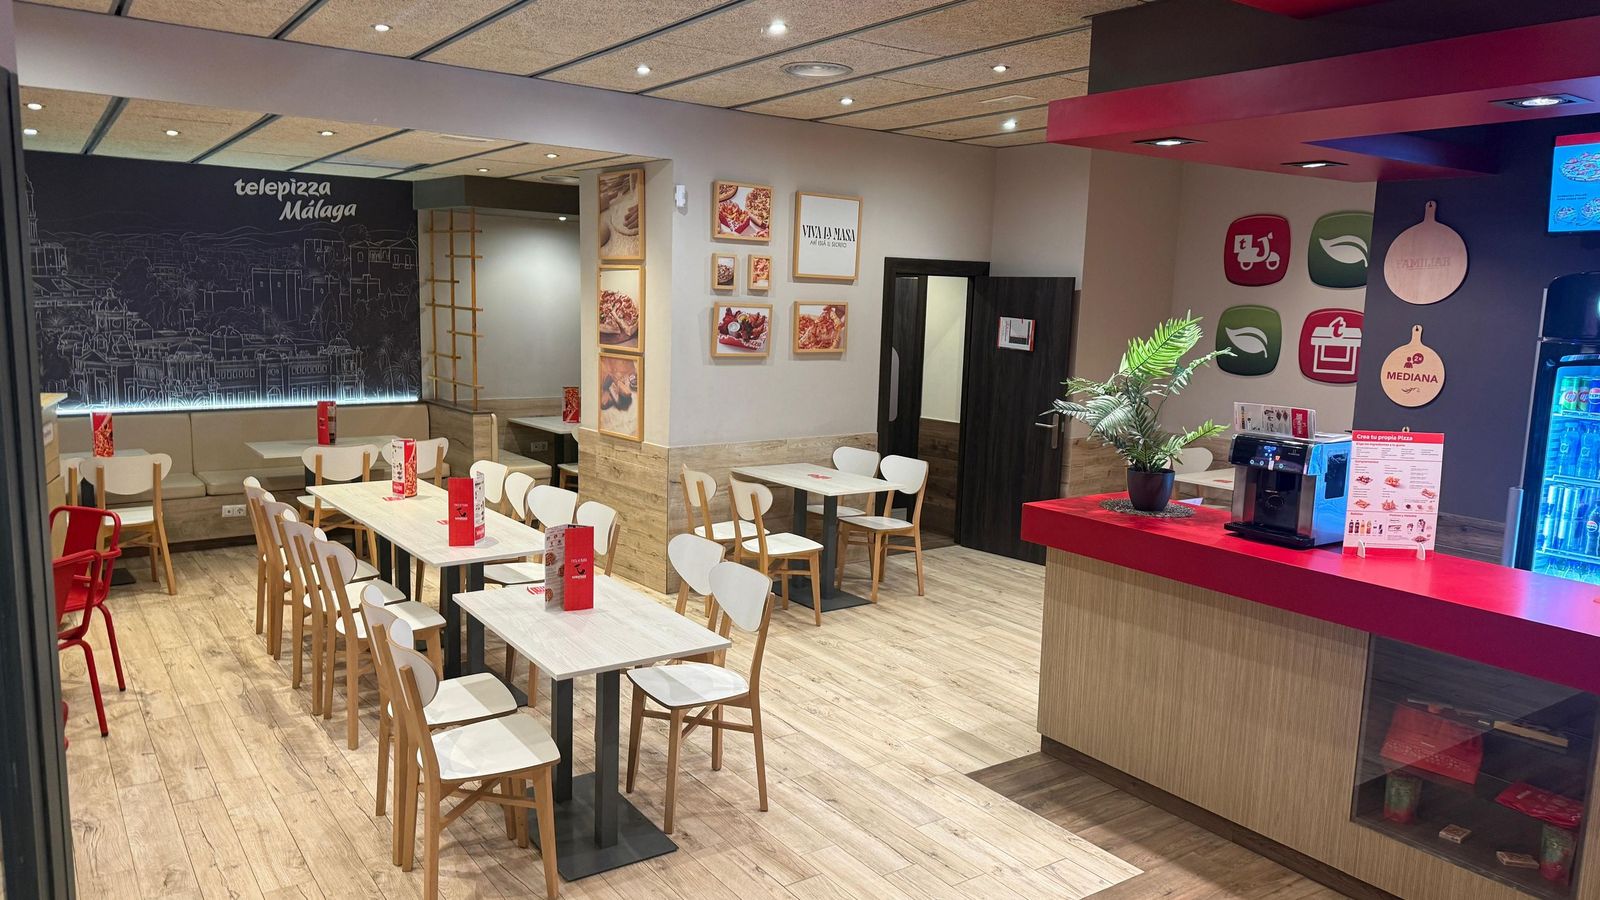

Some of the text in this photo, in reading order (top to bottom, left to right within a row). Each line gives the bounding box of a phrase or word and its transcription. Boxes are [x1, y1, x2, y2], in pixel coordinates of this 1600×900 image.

[234, 178, 331, 201] telepizza
[279, 199, 357, 223] Málaga
[802, 224, 822, 238] VIVA
[834, 228, 855, 241] MASA
[1387, 371, 1438, 383] MEDIANA
